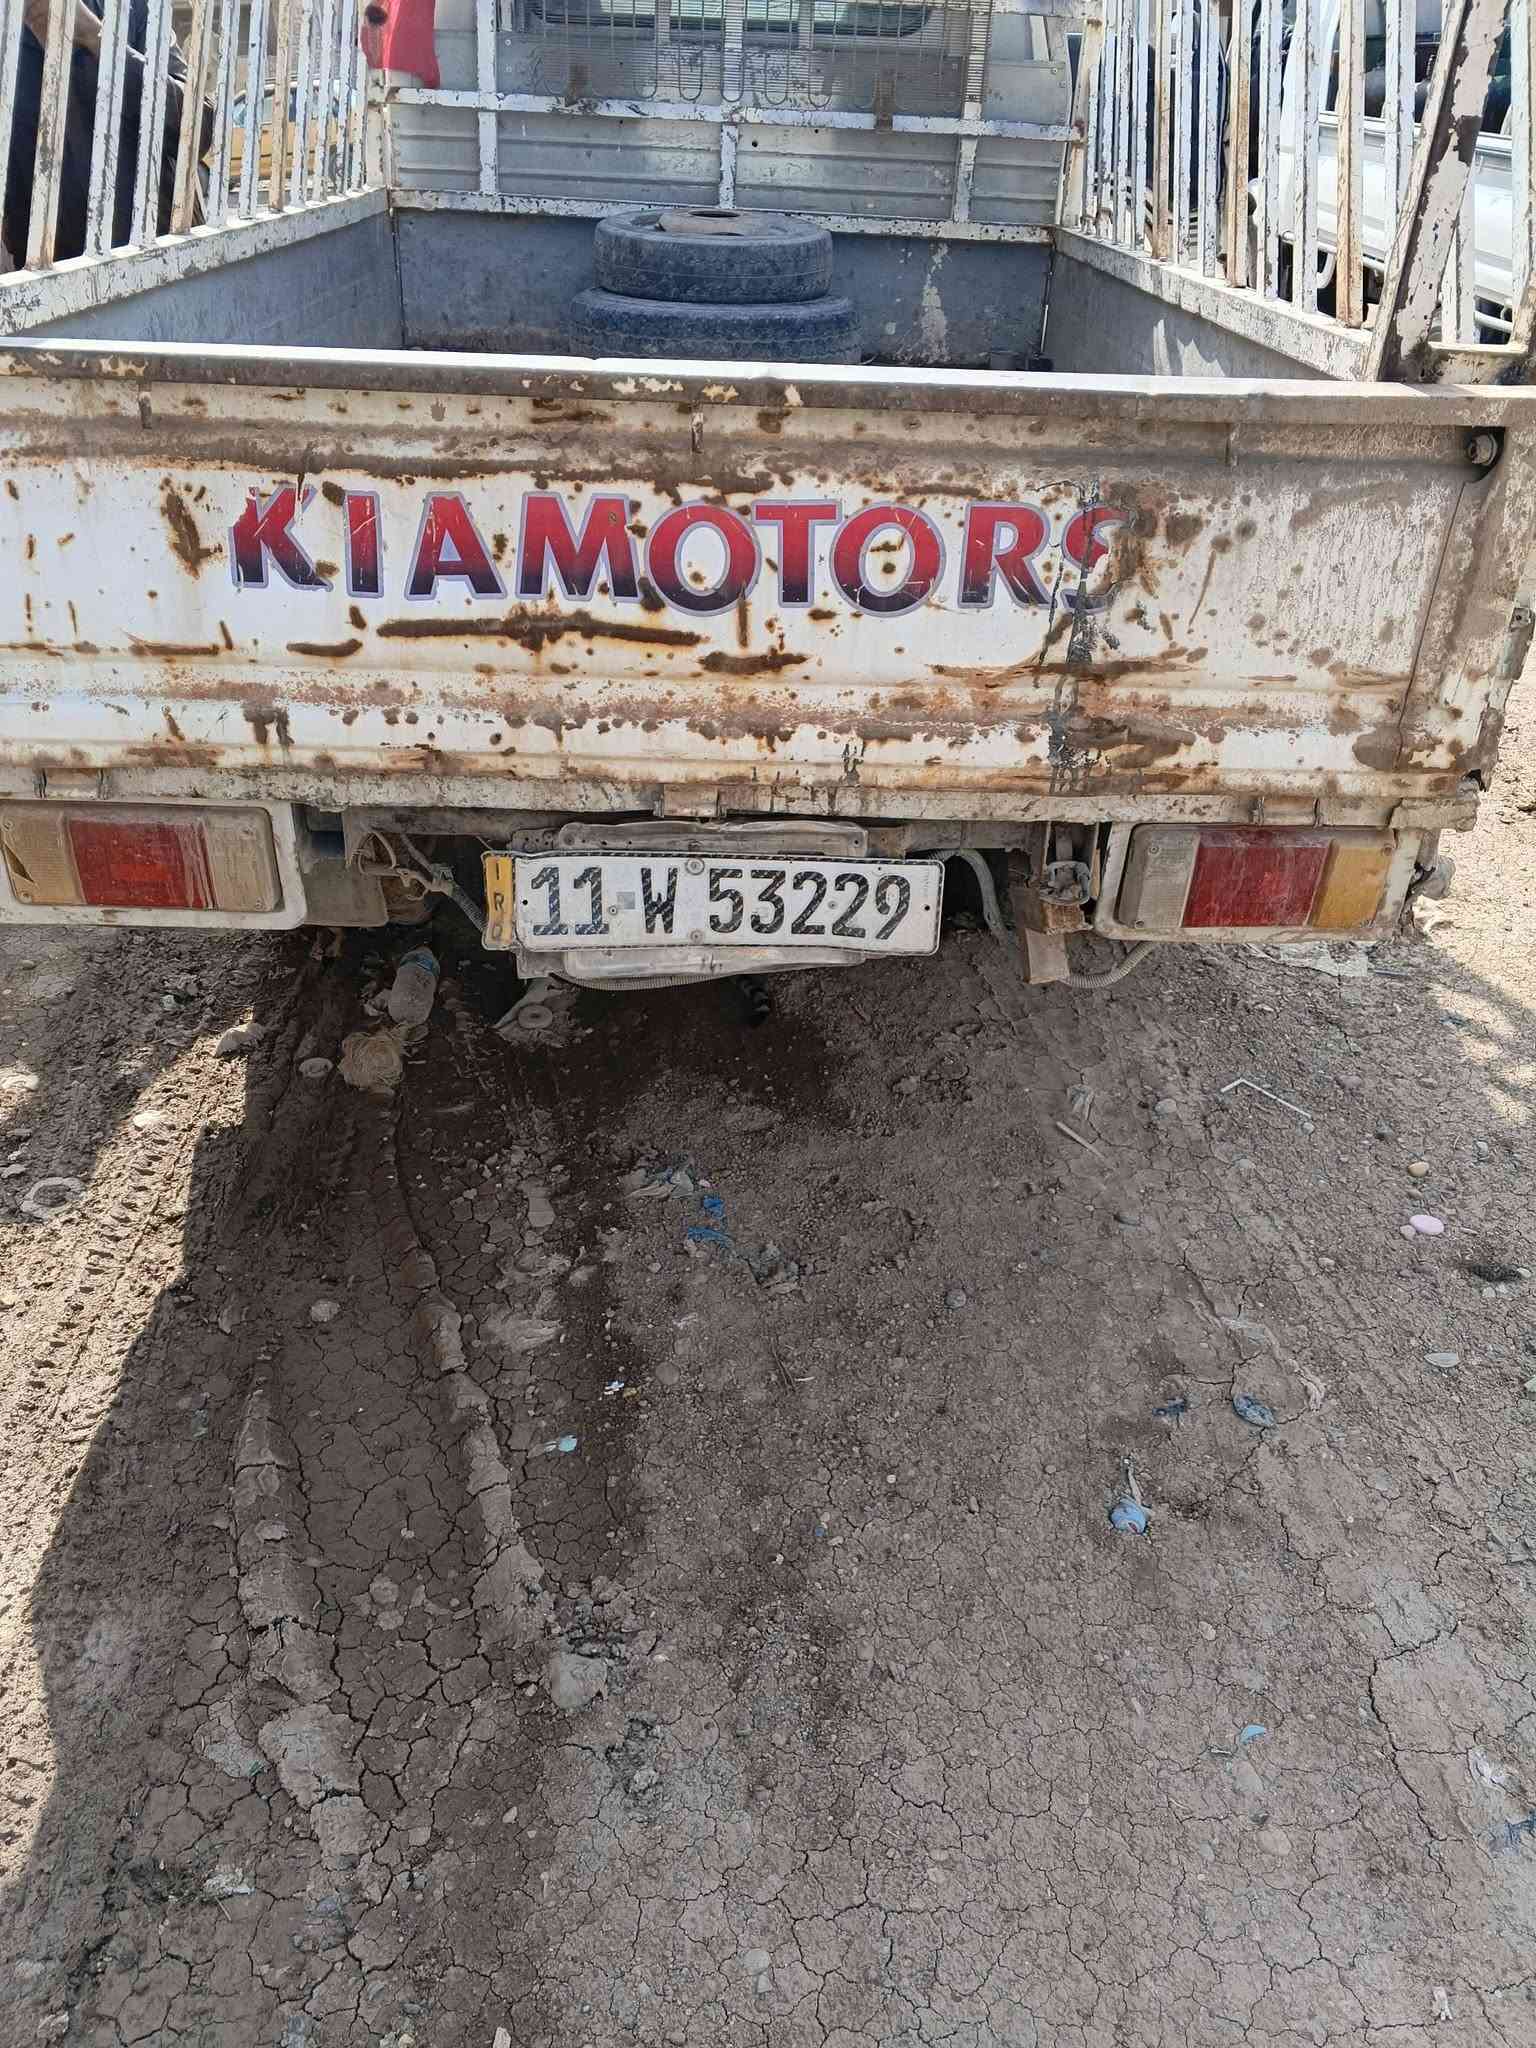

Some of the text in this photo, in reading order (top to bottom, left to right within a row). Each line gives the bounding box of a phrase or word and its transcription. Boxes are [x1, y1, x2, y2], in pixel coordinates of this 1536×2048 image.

[531, 866, 911, 940] 11 W 53229
